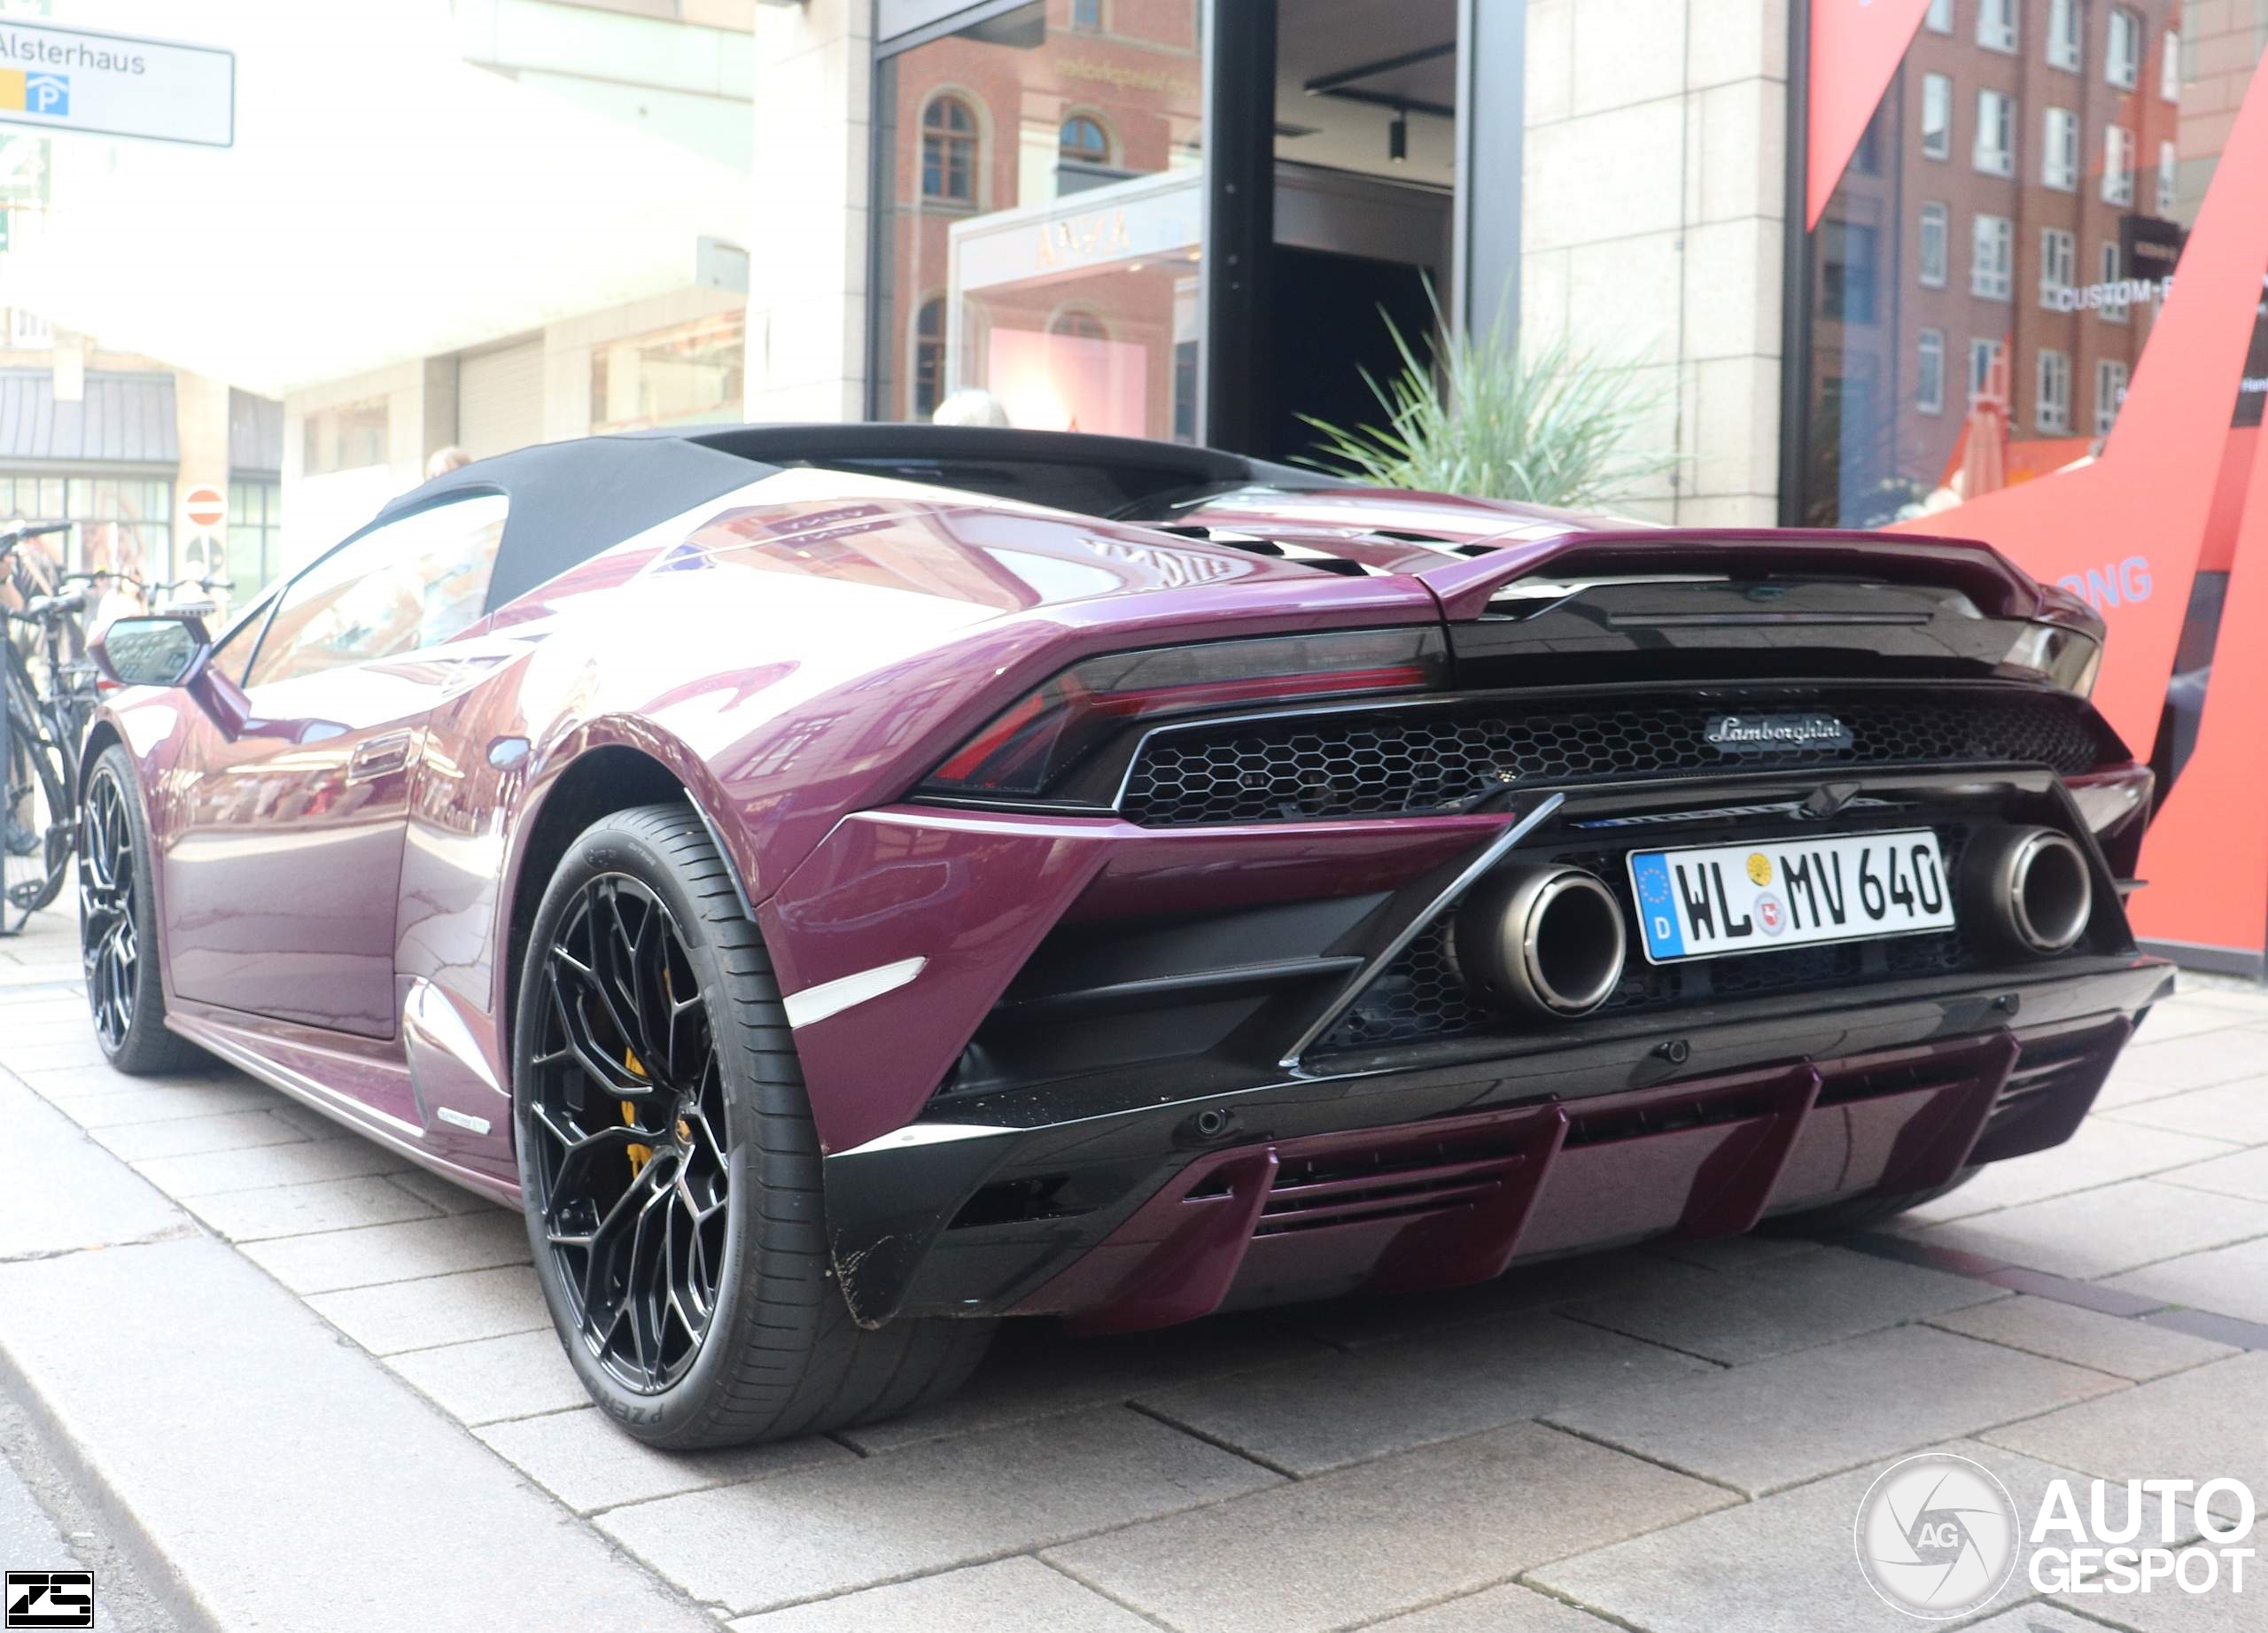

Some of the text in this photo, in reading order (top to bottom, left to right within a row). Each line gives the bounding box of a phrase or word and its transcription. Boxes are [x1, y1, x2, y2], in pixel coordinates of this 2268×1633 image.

[38, 86, 58, 112] P
[1709, 716, 1842, 745] Lamborghini
[1676, 844, 1943, 941] WL MV 640
[1655, 916, 1671, 940] D
